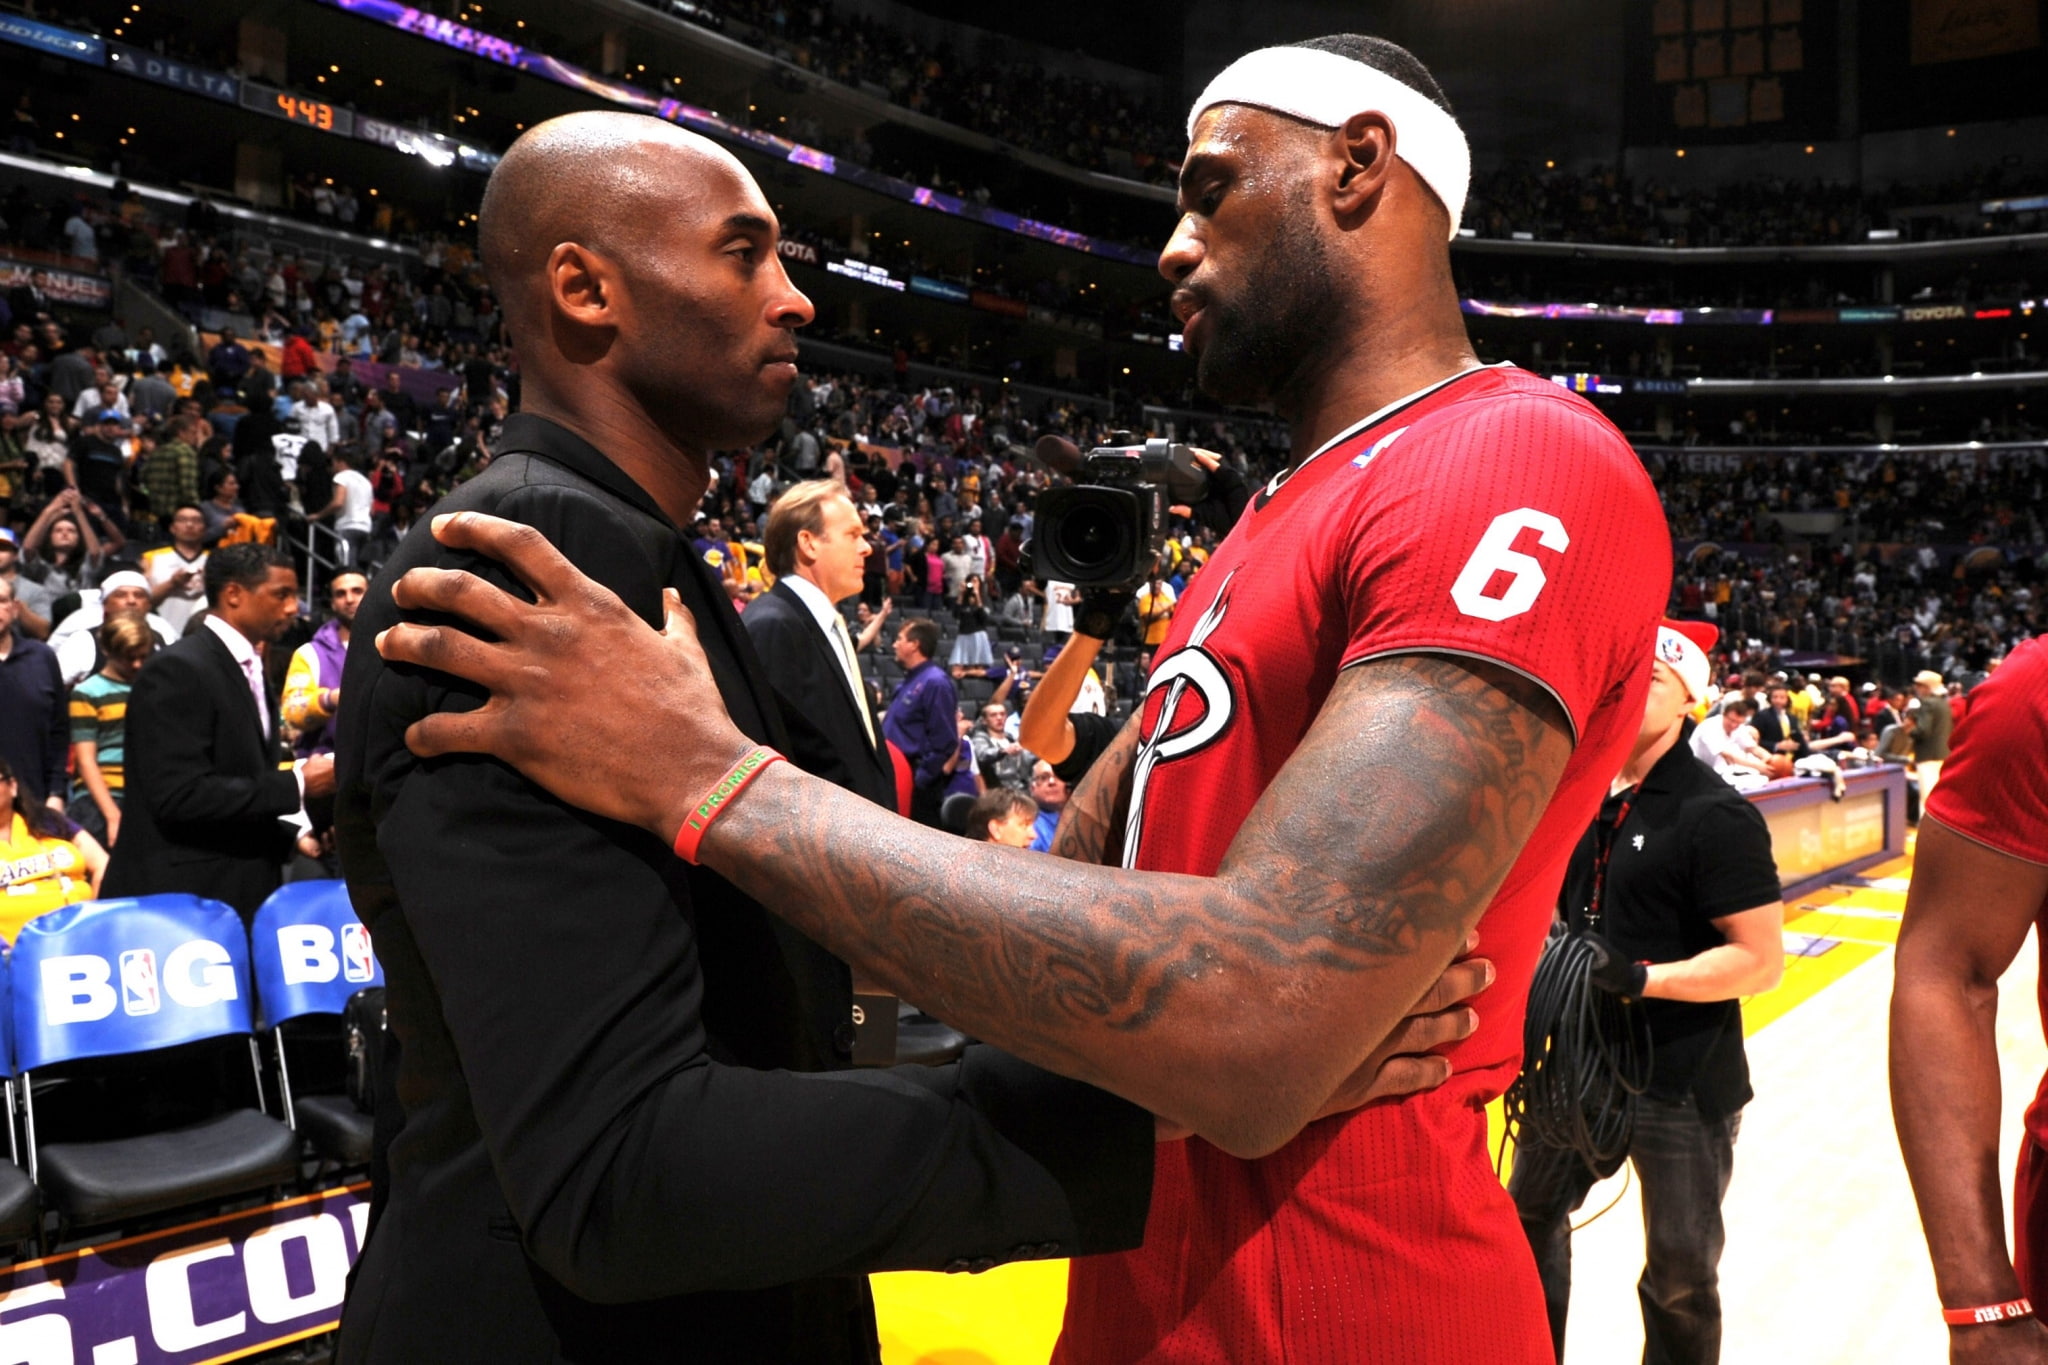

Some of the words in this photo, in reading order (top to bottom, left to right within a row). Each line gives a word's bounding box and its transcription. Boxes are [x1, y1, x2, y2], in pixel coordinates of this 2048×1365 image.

[146, 61, 233, 97] DELTA
[9, 265, 103, 296] MNUEL
[1903, 306, 1966, 321] TOYOTA
[1450, 507, 1570, 622] 6
[689, 819, 700, 830] I
[697, 750, 767, 819] PROMISE
[0, 1202, 371, 1365] S.CO
[1974, 1305, 2003, 1323] SELF
[2006, 1301, 2023, 1317] TO
